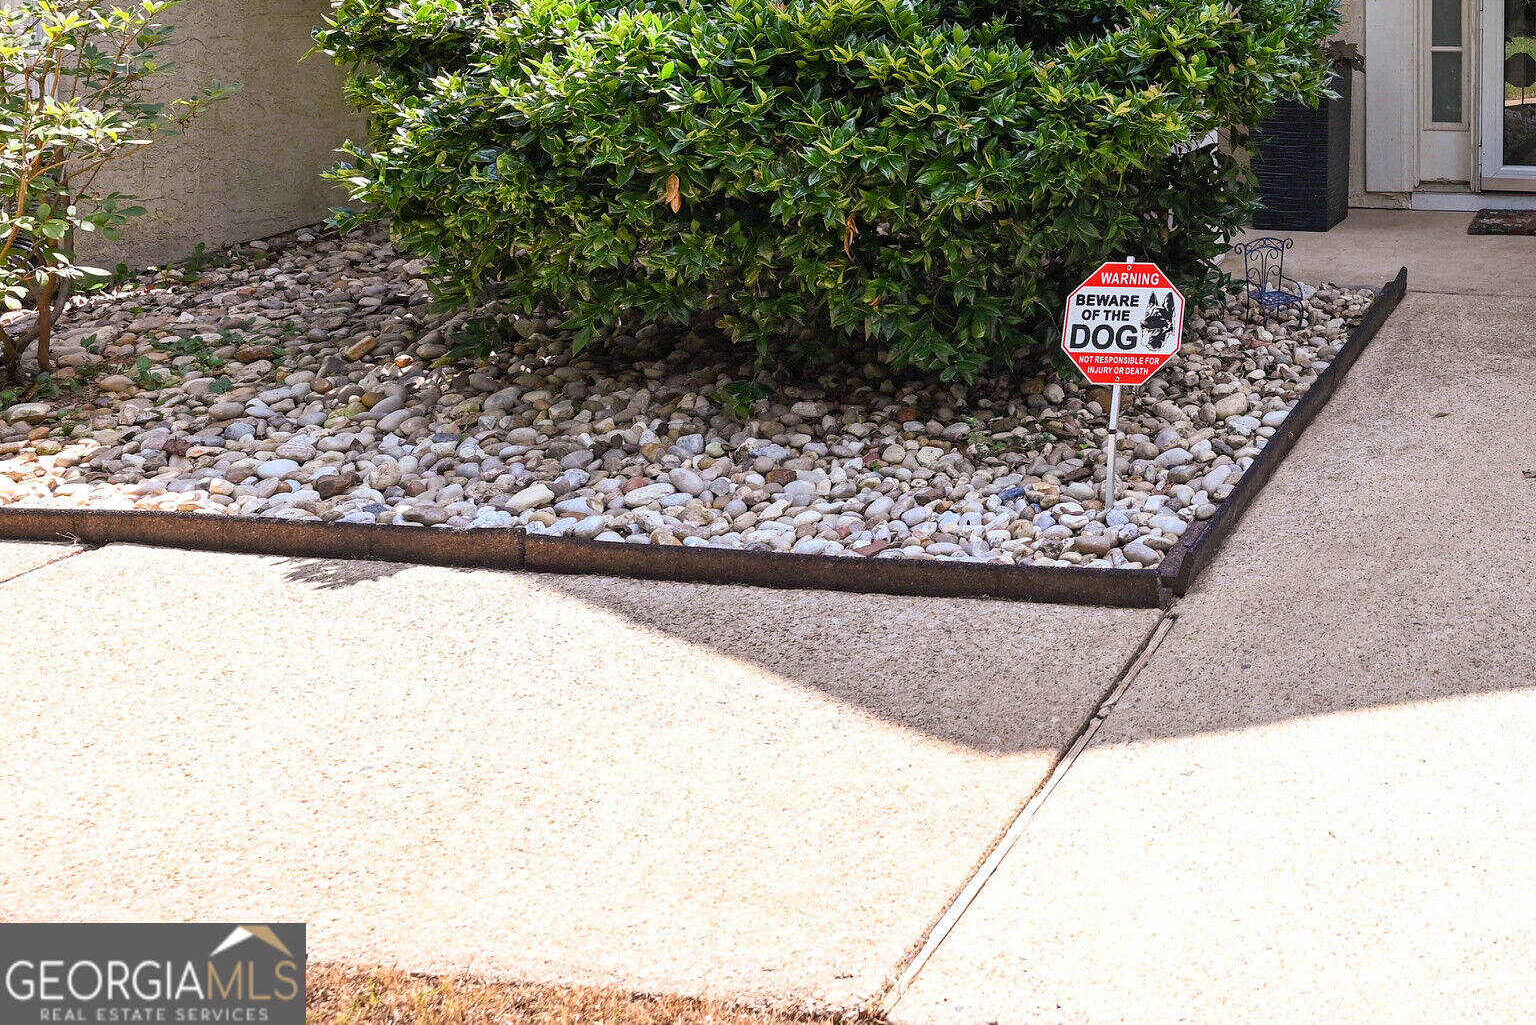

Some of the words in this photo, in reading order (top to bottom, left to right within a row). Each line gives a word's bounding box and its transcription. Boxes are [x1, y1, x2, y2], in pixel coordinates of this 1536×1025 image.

[1101, 272, 1160, 285] WARNING
[1076, 294, 1139, 307] BEWARE
[1081, 310, 1100, 321] OF
[1103, 310, 1130, 321] THE
[1069, 324, 1138, 350] DOG
[1095, 356, 1144, 364] RESPONSIBLE
[1145, 357, 1160, 365] FOR
[1087, 366, 1113, 374] INJURY
[1125, 367, 1149, 375] DEATH
